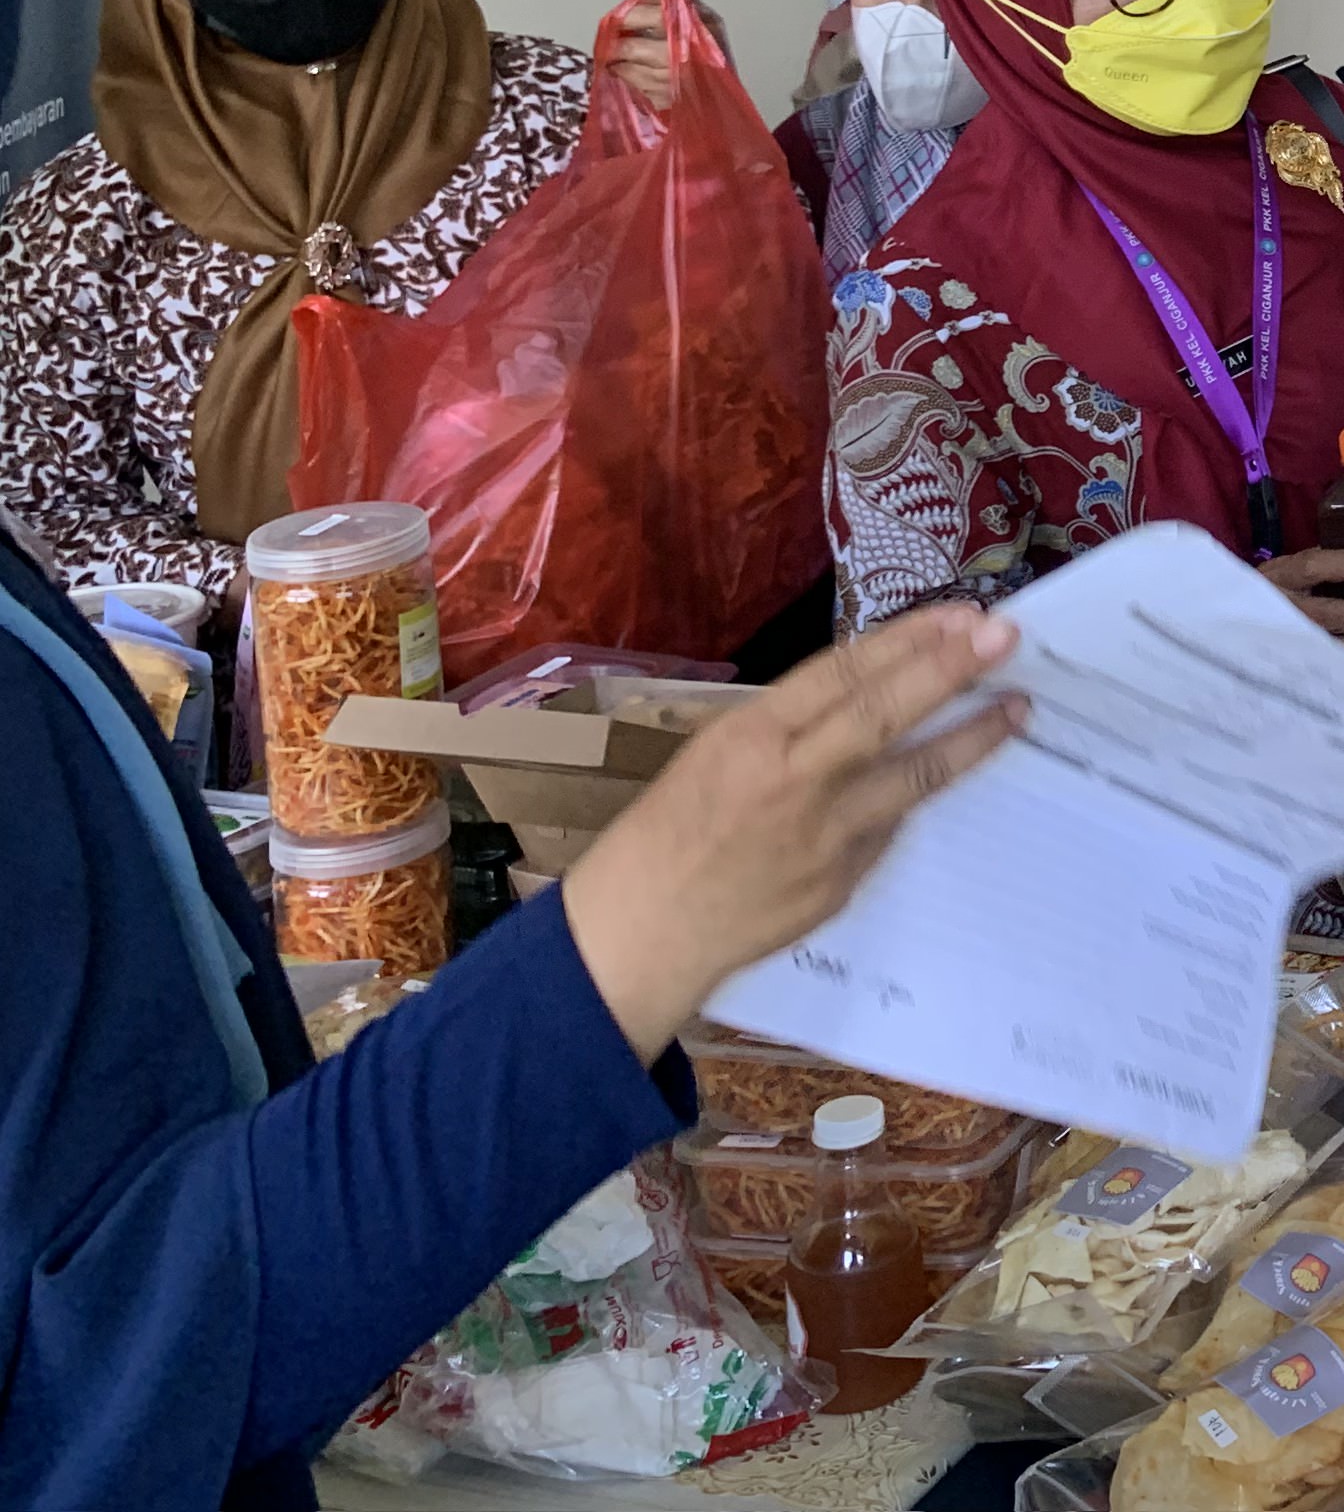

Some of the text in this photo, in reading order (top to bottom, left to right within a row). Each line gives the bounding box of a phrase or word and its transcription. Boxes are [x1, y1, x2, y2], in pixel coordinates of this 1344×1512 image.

[1262, 206, 1273, 232] PKK
[1150, 272, 1189, 331] CIGANJUR
[1261, 260, 1273, 322] CIGANJUR
[1197, 357, 1217, 385] PKK
[1260, 353, 1270, 380] PKK
